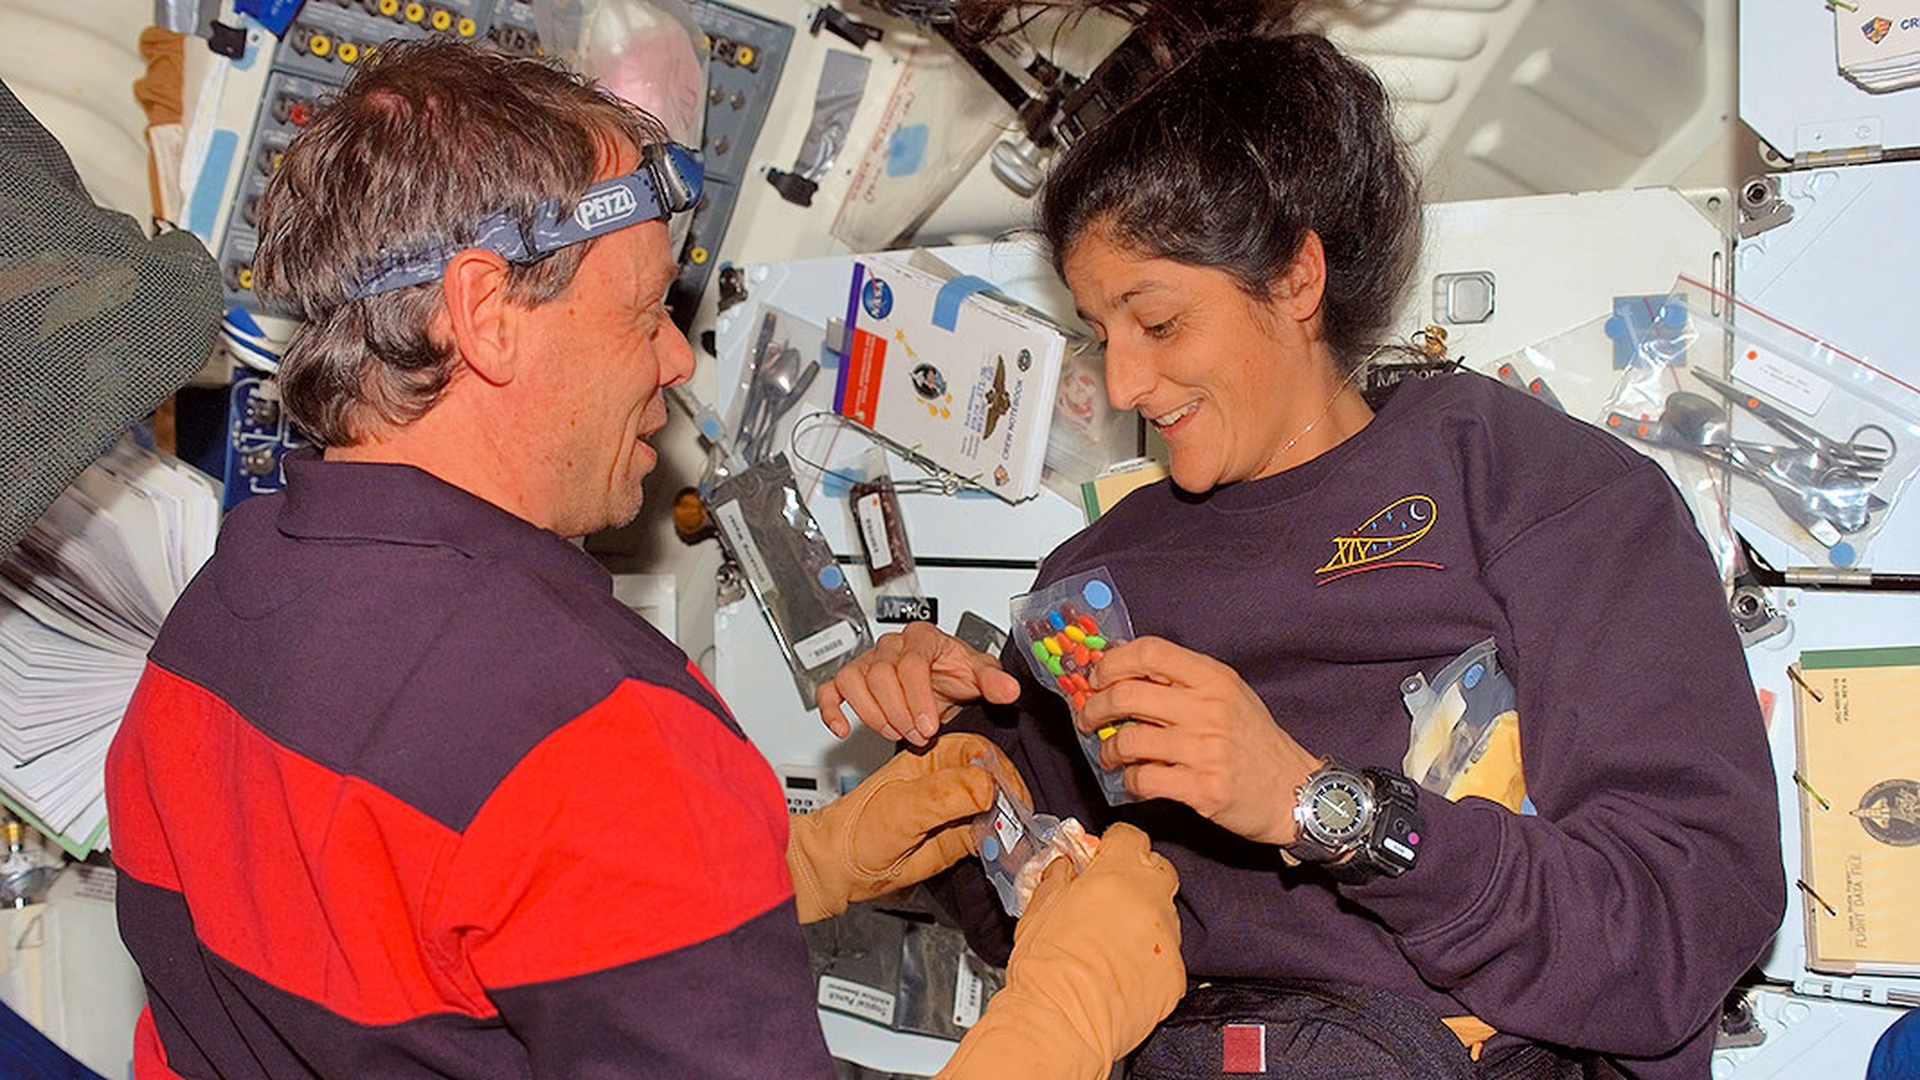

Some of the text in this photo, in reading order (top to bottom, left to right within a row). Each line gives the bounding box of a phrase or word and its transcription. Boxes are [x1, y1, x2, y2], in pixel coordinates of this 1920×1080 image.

[1900, 17, 1920, 31] CR
[578, 187, 638, 231] PETZL
[1001, 379, 1023, 461] CREW NOTEBOOK
[1315, 537, 1374, 574] XIV
[1849, 854, 1868, 949] FLIGHT DATA FILE
